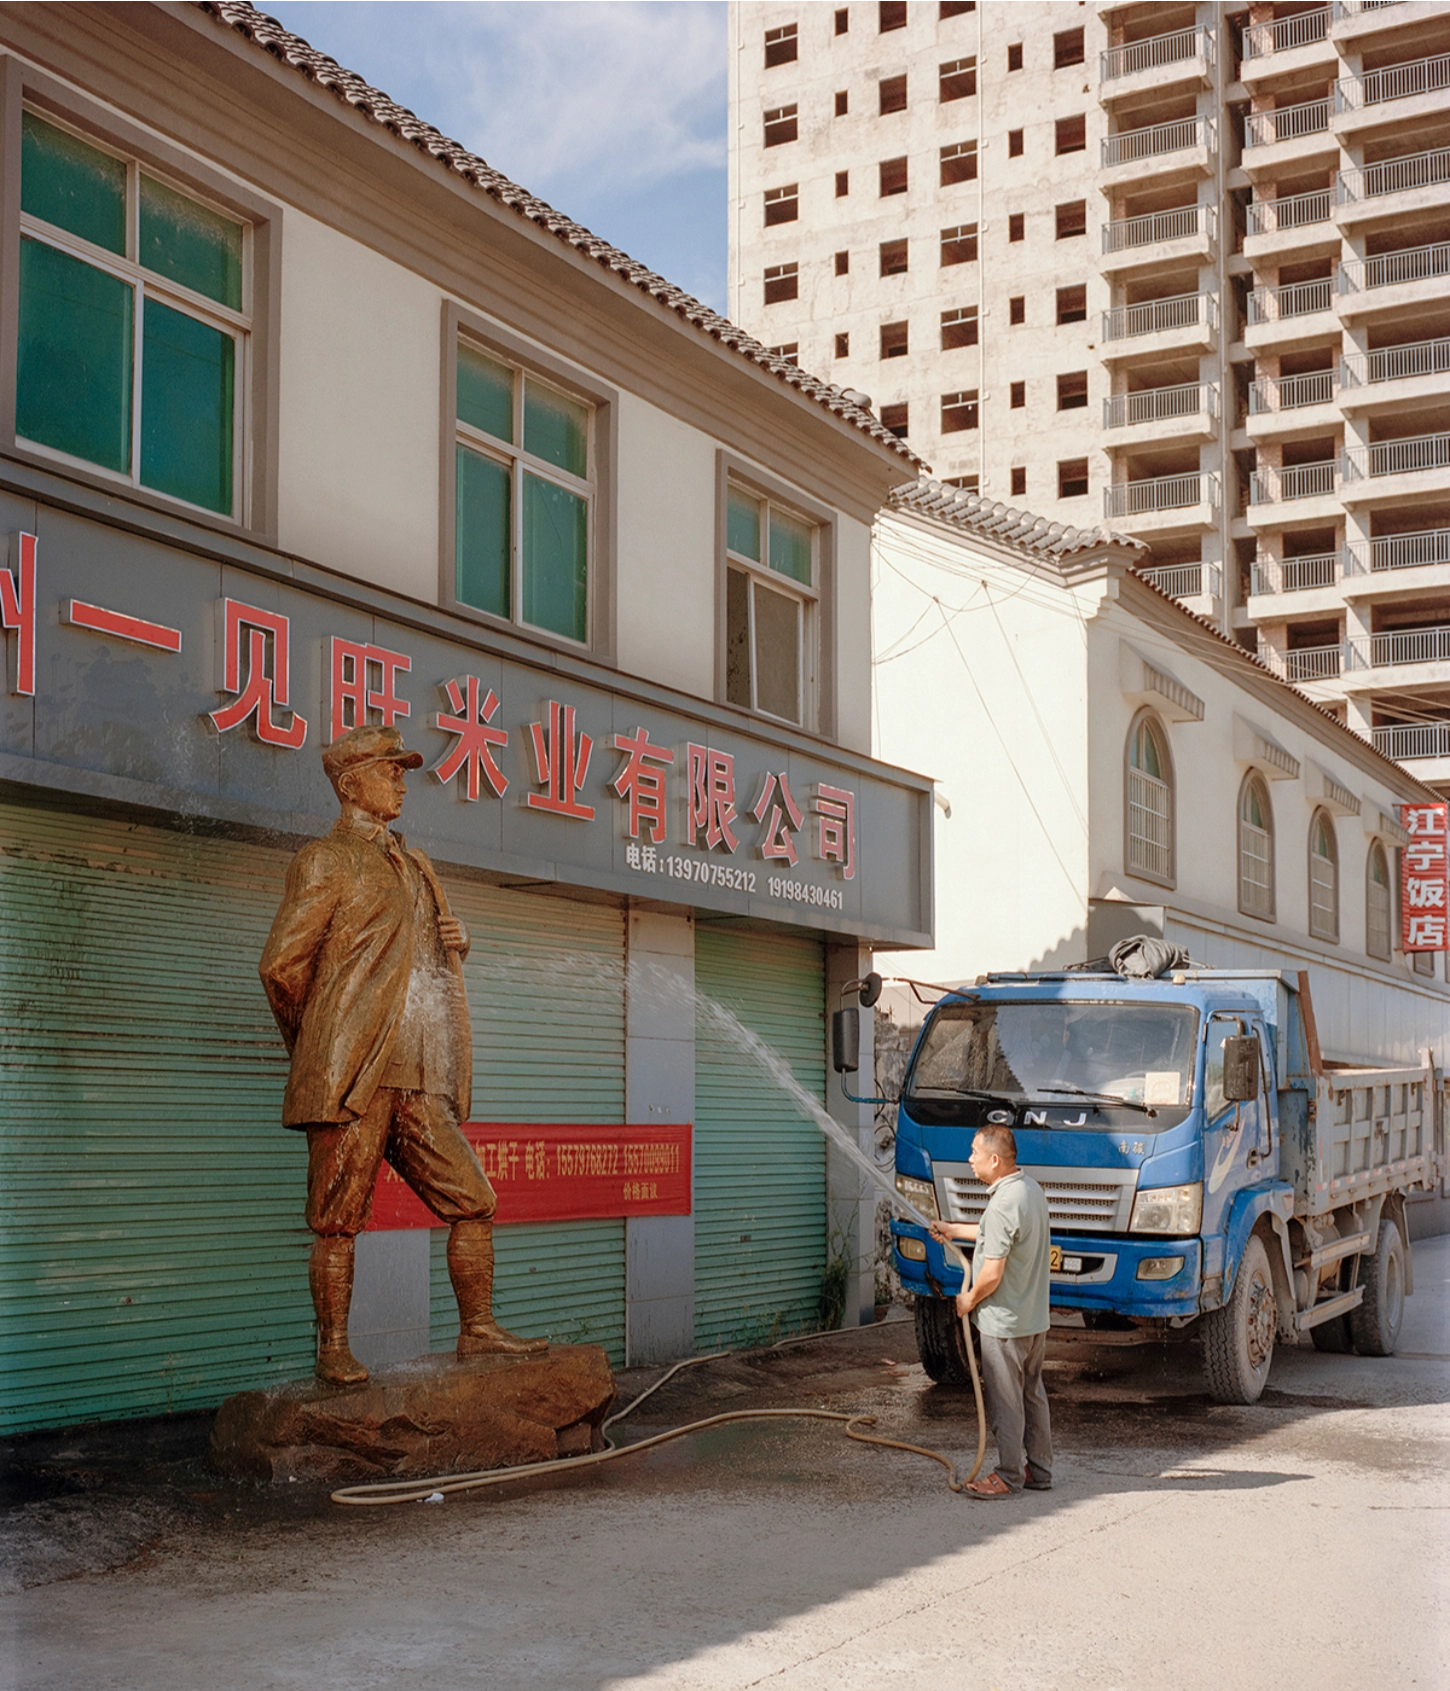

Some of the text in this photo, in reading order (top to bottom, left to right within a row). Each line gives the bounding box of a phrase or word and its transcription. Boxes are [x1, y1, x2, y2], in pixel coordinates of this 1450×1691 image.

[767, 876, 843, 910] 19198430461
[1406, 807, 1446, 947] 江宁饭店
[986, 1109, 1088, 1128] CNJ
[557, 1144, 618, 1176] 15579768272
[623, 1181, 658, 1200] 价格面议
